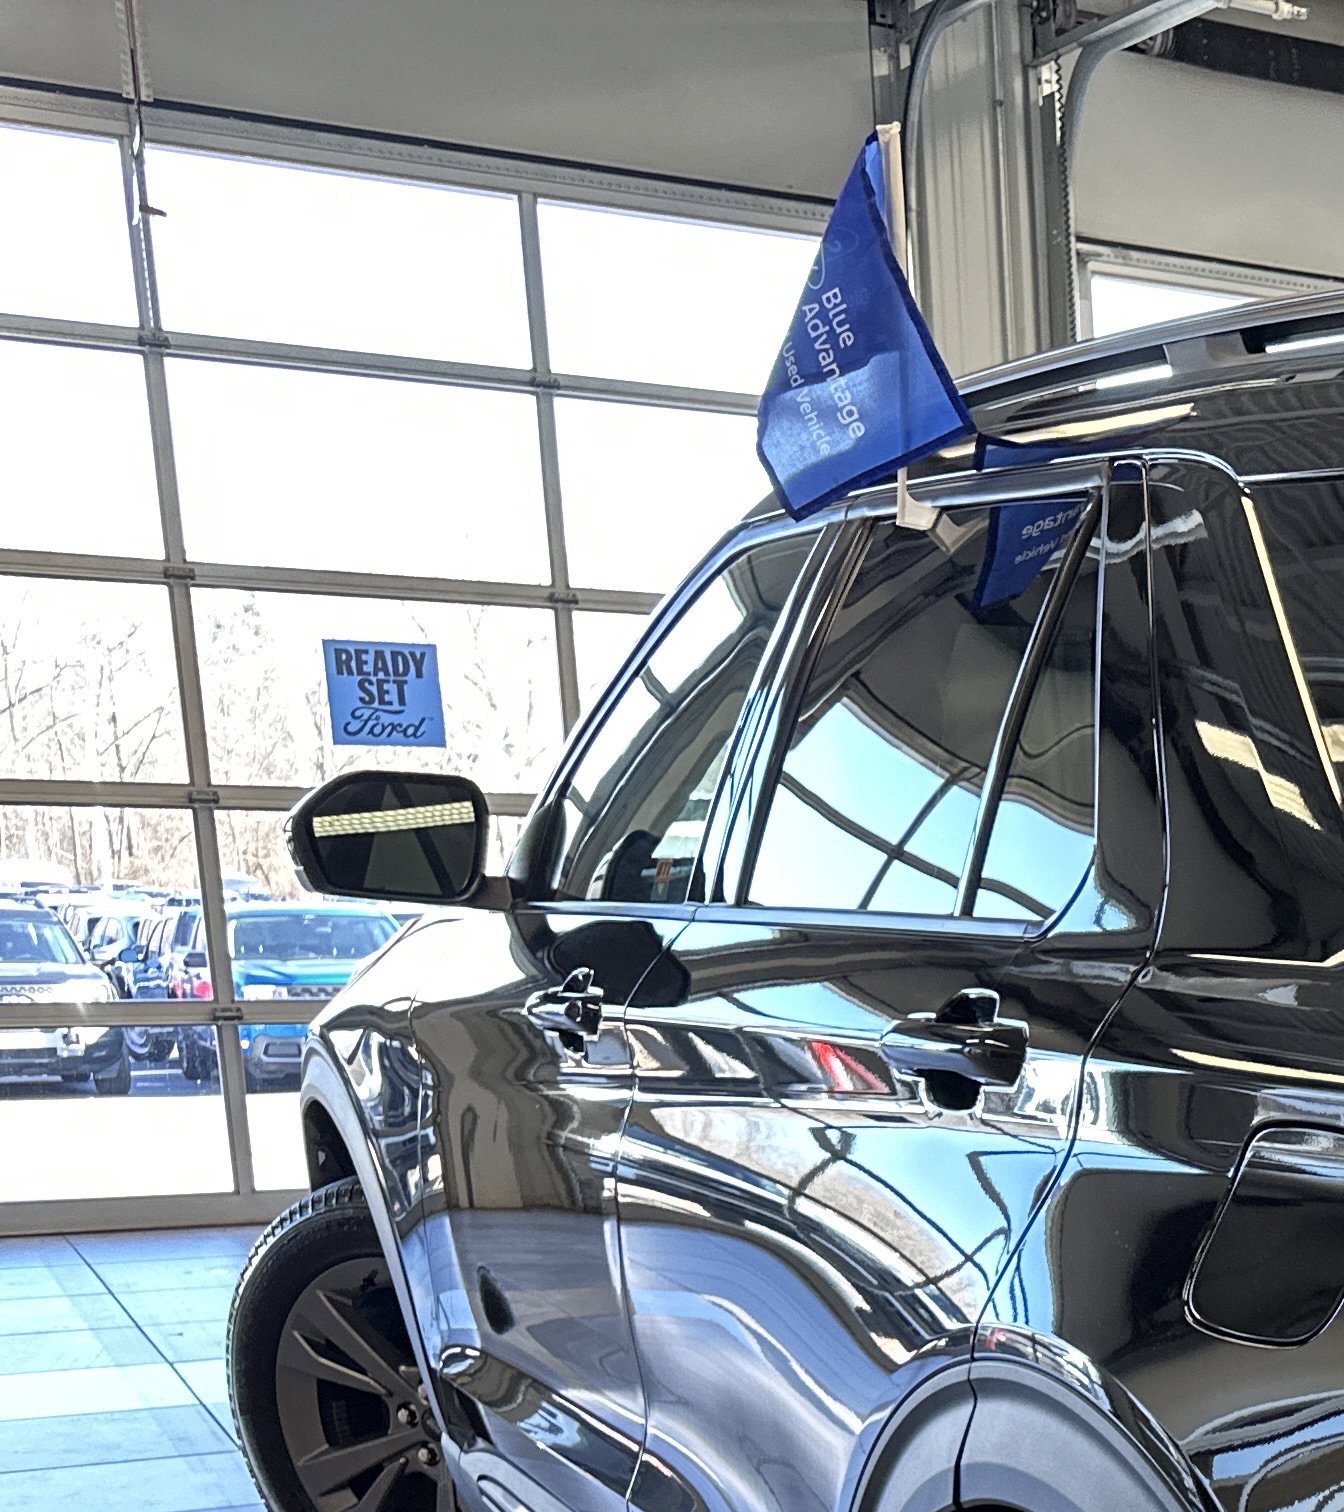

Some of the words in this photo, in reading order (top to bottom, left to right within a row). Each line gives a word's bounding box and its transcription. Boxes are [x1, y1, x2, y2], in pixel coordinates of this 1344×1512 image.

[822, 287, 855, 349] Blue
[801, 302, 866, 438] Advantage
[782, 341, 805, 388] Used
[795, 389, 831, 456] Vehicle
[333, 647, 427, 679] READY
[357, 677, 408, 707] SET
[343, 706, 426, 739] Ford
